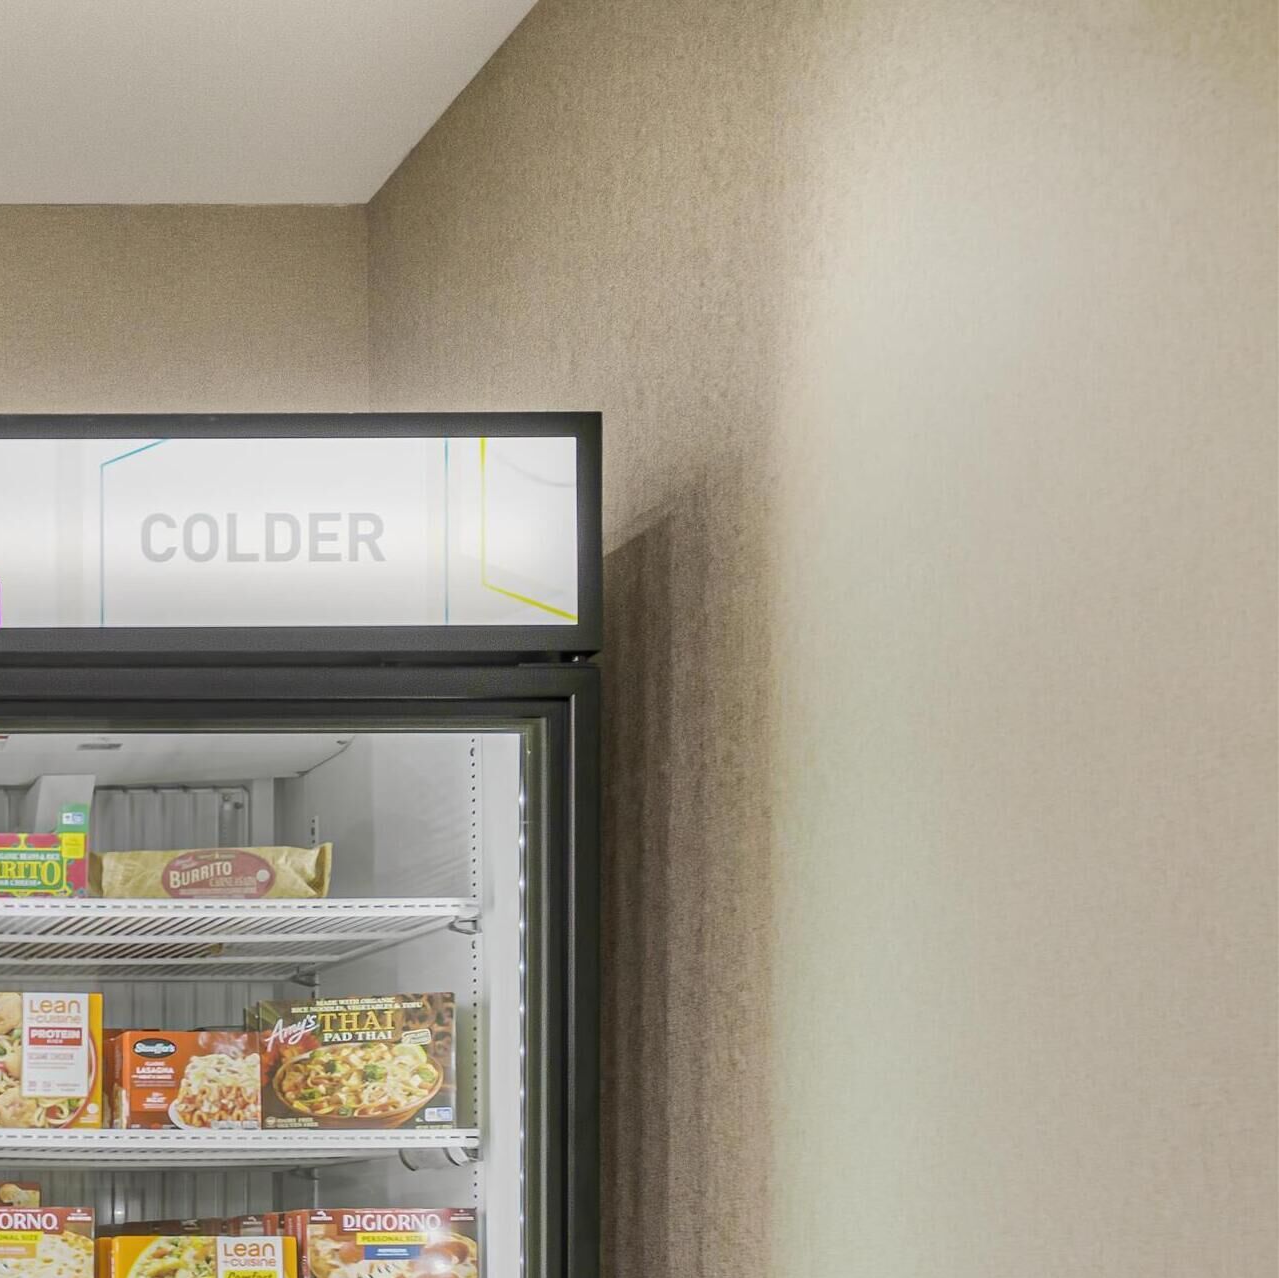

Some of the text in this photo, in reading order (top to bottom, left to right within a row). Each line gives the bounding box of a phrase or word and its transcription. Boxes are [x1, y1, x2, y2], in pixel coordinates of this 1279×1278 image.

[140, 511, 385, 564] COLDER
[169, 862, 233, 889] BURRITO
[29, 999, 82, 1014] Lean
[318, 1010, 396, 1032] THAI
[264, 1013, 321, 1052] Amy's
[323, 1031, 393, 1042] PAD THAI
[223, 1242, 276, 1257] Lean
[230, 1257, 276, 1267] cuisine
